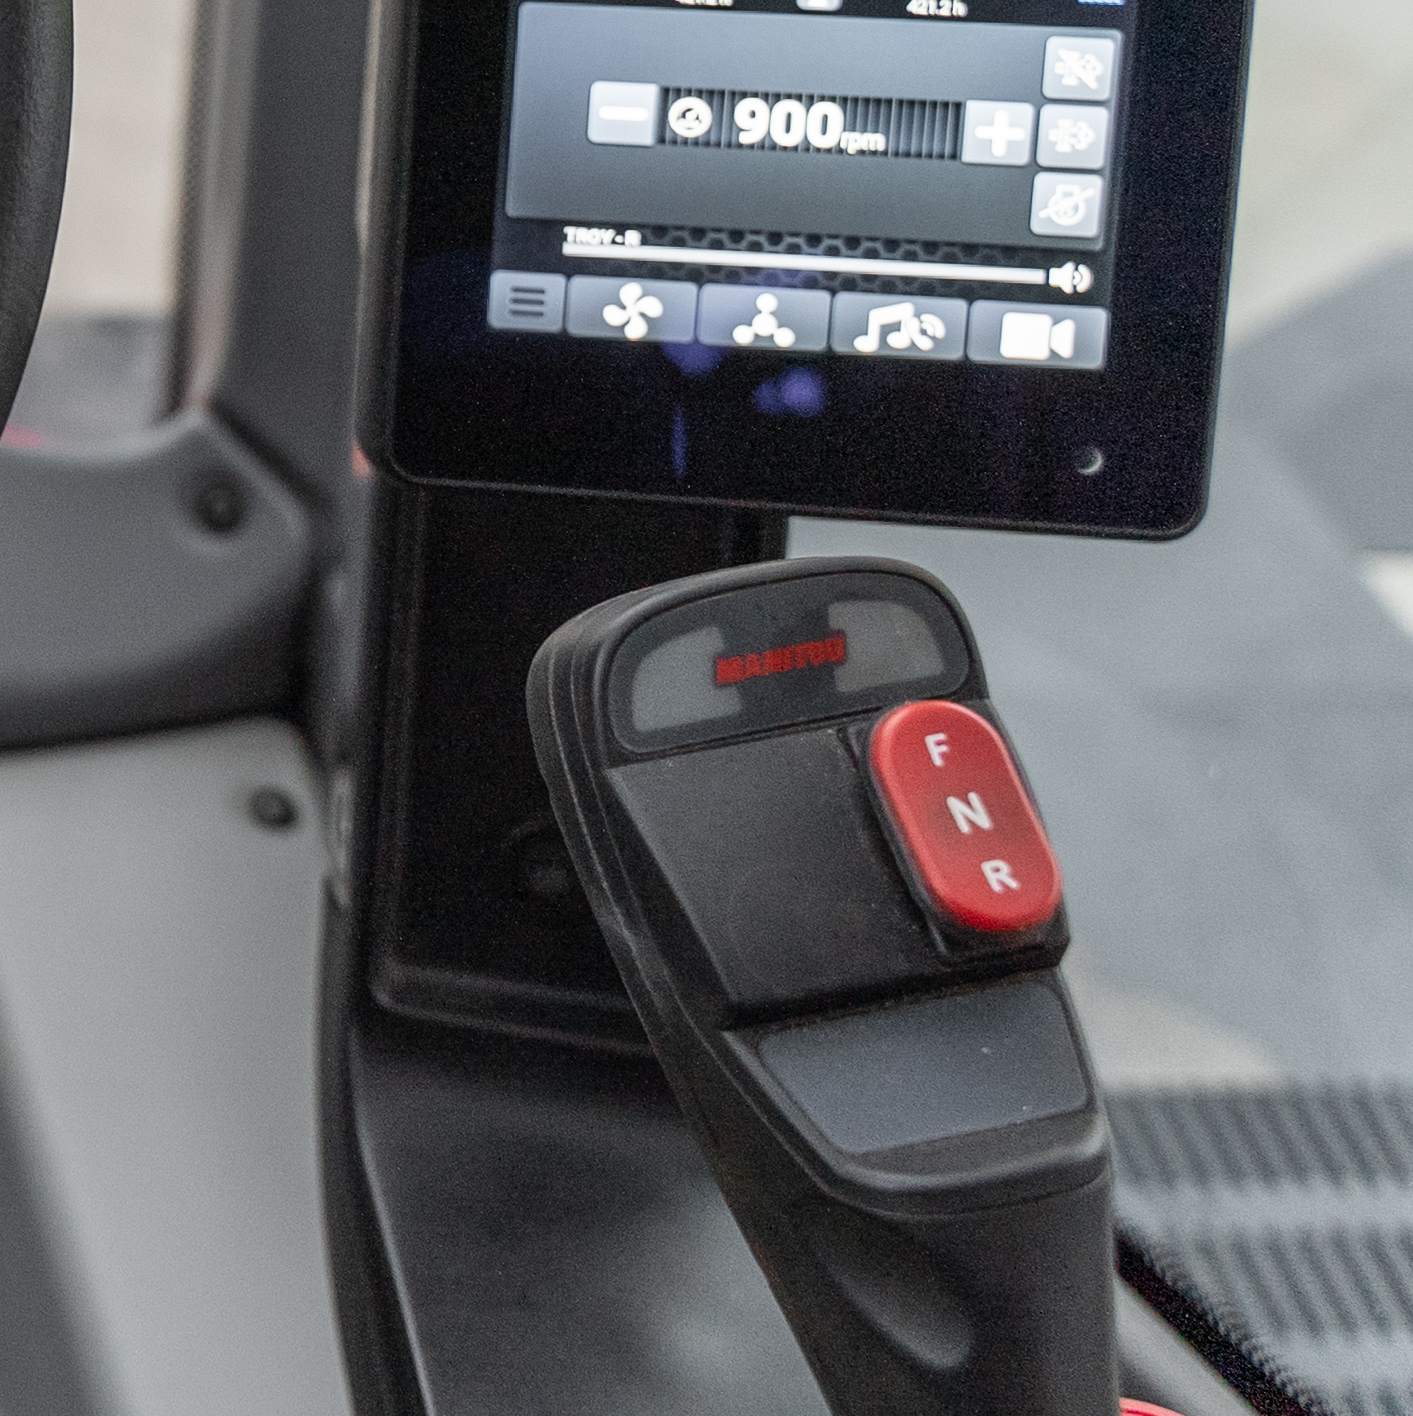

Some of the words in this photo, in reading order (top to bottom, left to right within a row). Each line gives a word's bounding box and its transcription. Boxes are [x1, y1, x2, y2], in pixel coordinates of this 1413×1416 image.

[734, 97, 844, 149] 900
[840, 131, 886, 155] rpm
[715, 634, 846, 686] MANITOU
[924, 731, 949, 767] F
[946, 791, 993, 834] N
[981, 859, 1019, 894] R
